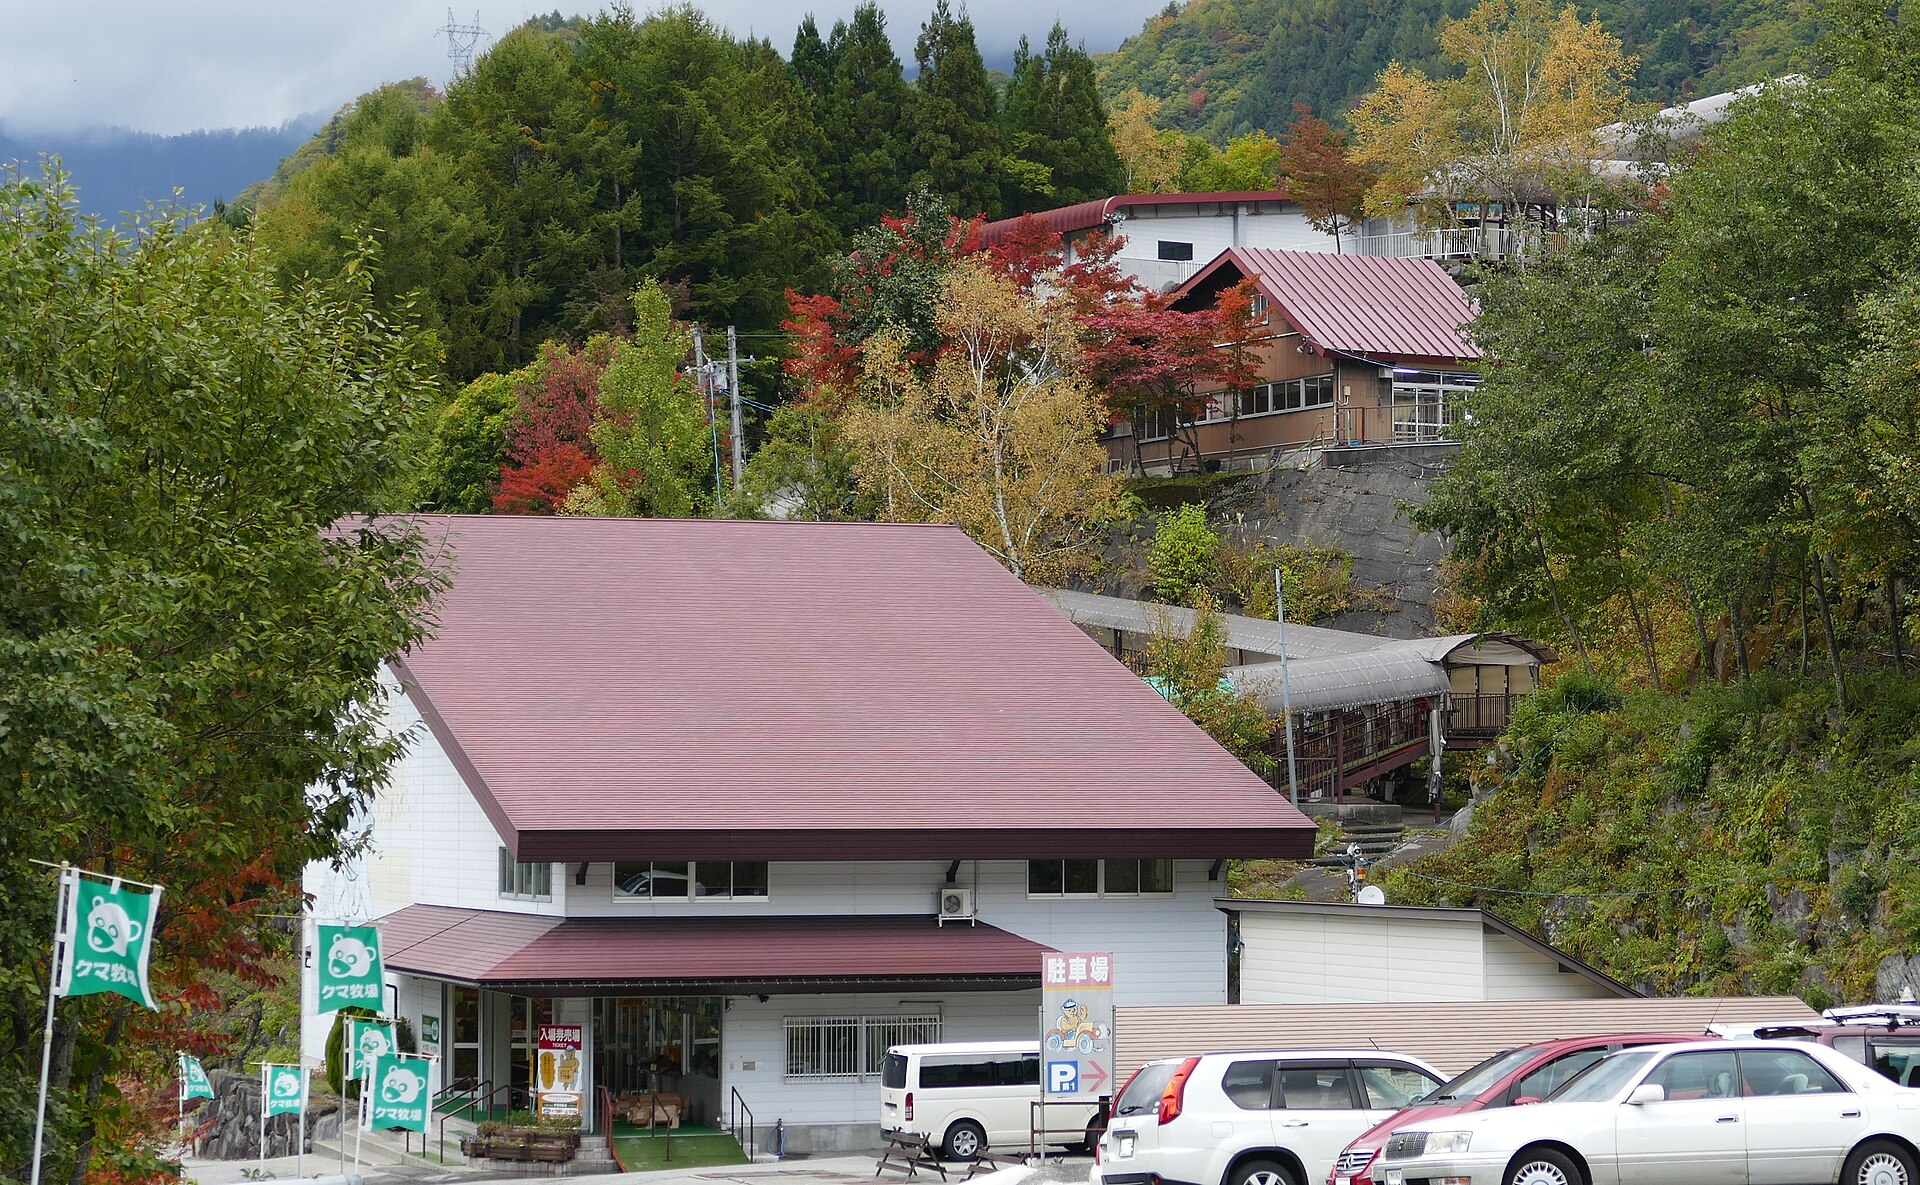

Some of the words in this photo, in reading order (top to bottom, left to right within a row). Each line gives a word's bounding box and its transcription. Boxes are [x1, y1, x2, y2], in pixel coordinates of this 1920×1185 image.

[1047, 956, 1108, 983] 駐車場
[321, 984, 378, 1000] クマ牧場
[540, 1028, 581, 1042] 入場券売場
[375, 1107, 422, 1121] クマ牧場
